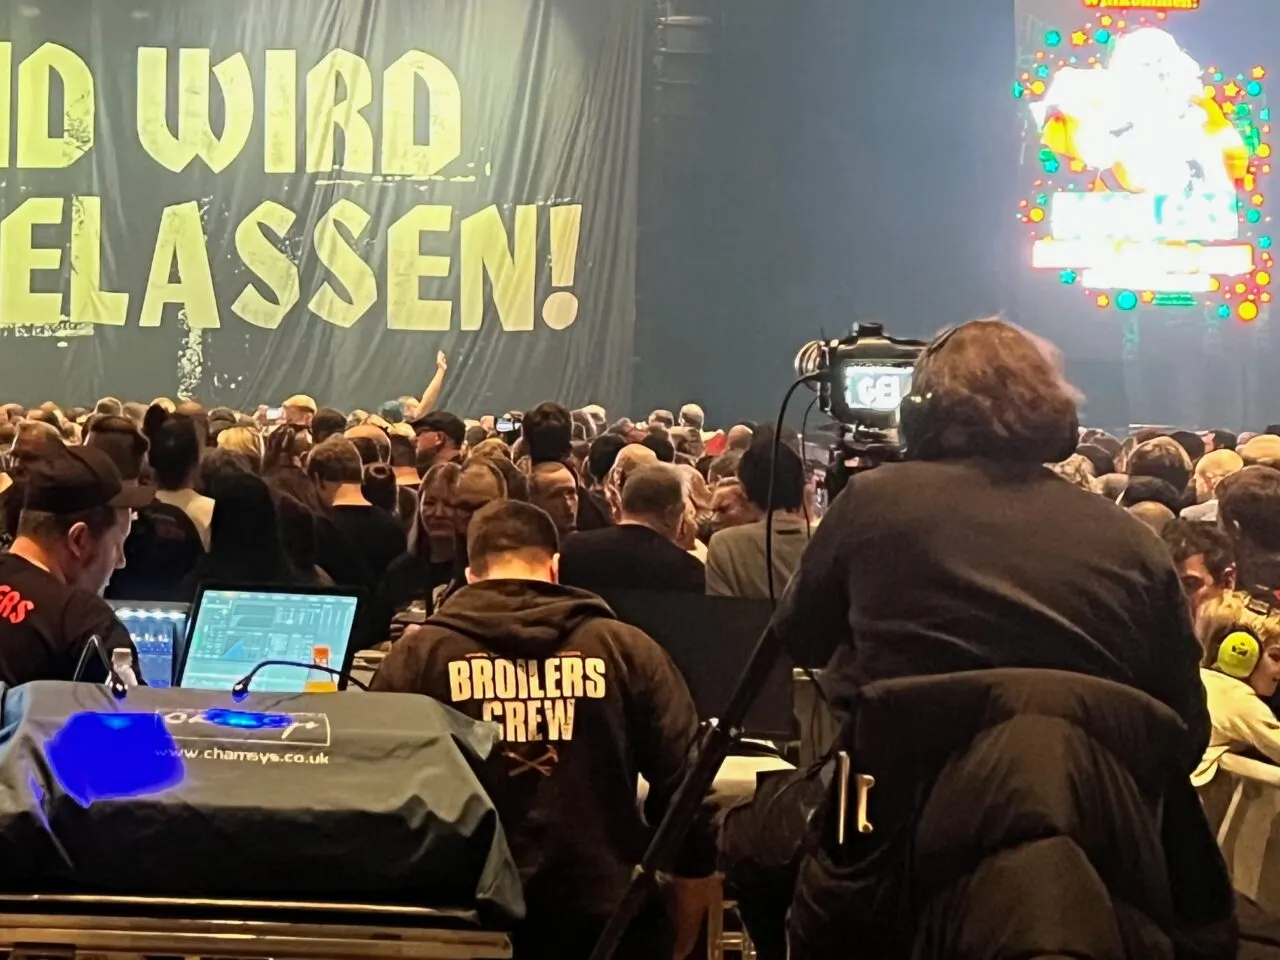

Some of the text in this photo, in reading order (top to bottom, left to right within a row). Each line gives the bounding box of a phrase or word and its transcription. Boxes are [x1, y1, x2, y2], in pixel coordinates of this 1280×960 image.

[136, 47, 462, 177] WIRD
[448, 657, 606, 702] BROILERS
[483, 698, 576, 743] CREW
